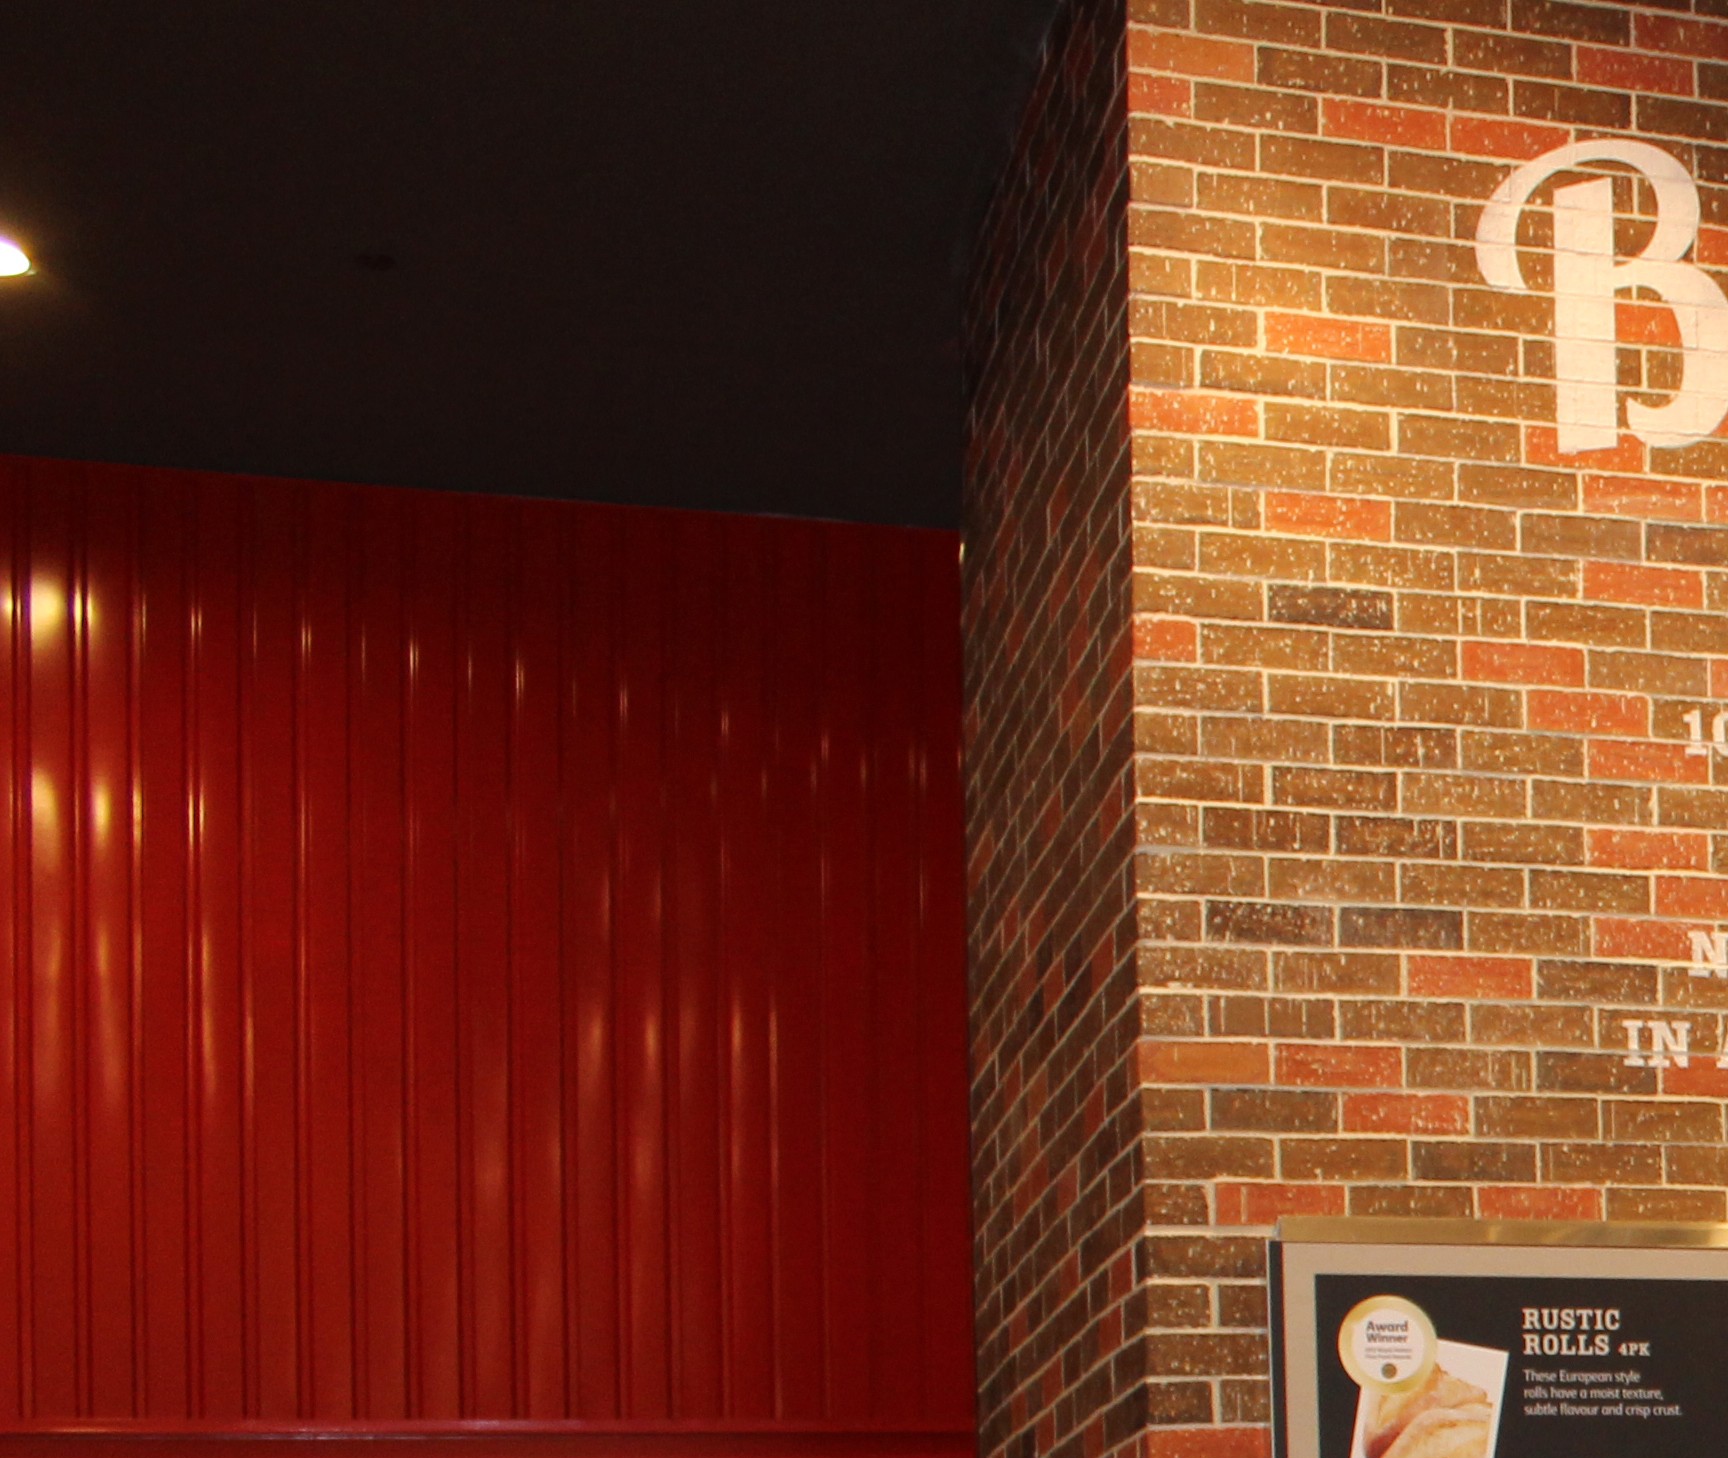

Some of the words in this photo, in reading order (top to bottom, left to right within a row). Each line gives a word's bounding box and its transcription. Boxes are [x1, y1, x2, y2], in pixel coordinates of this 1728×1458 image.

[1623, 1020, 1692, 1069] IN
[1366, 1320, 1408, 1333] Award
[1522, 1307, 1620, 1331] RUSTIC
[1366, 1332, 1408, 1344] Winner
[1523, 1333, 1610, 1356] ROLLS
[1618, 1343, 1651, 1356] 4PK
[1524, 1368, 1557, 1383] These
[1559, 1368, 1612, 1386] European
[1614, 1369, 1640, 1385] style
[1524, 1386, 1549, 1399] rolls
[1552, 1386, 1576, 1400] have
[1590, 1387, 1619, 1400] moist
[1622, 1388, 1664, 1402] texture,
[1524, 1403, 1557, 1416] subtle
[1560, 1403, 1598, 1417] flavour
[1601, 1403, 1622, 1417] and
[1625, 1404, 1650, 1419] crisp
[1653, 1405, 1682, 1417] crust.
